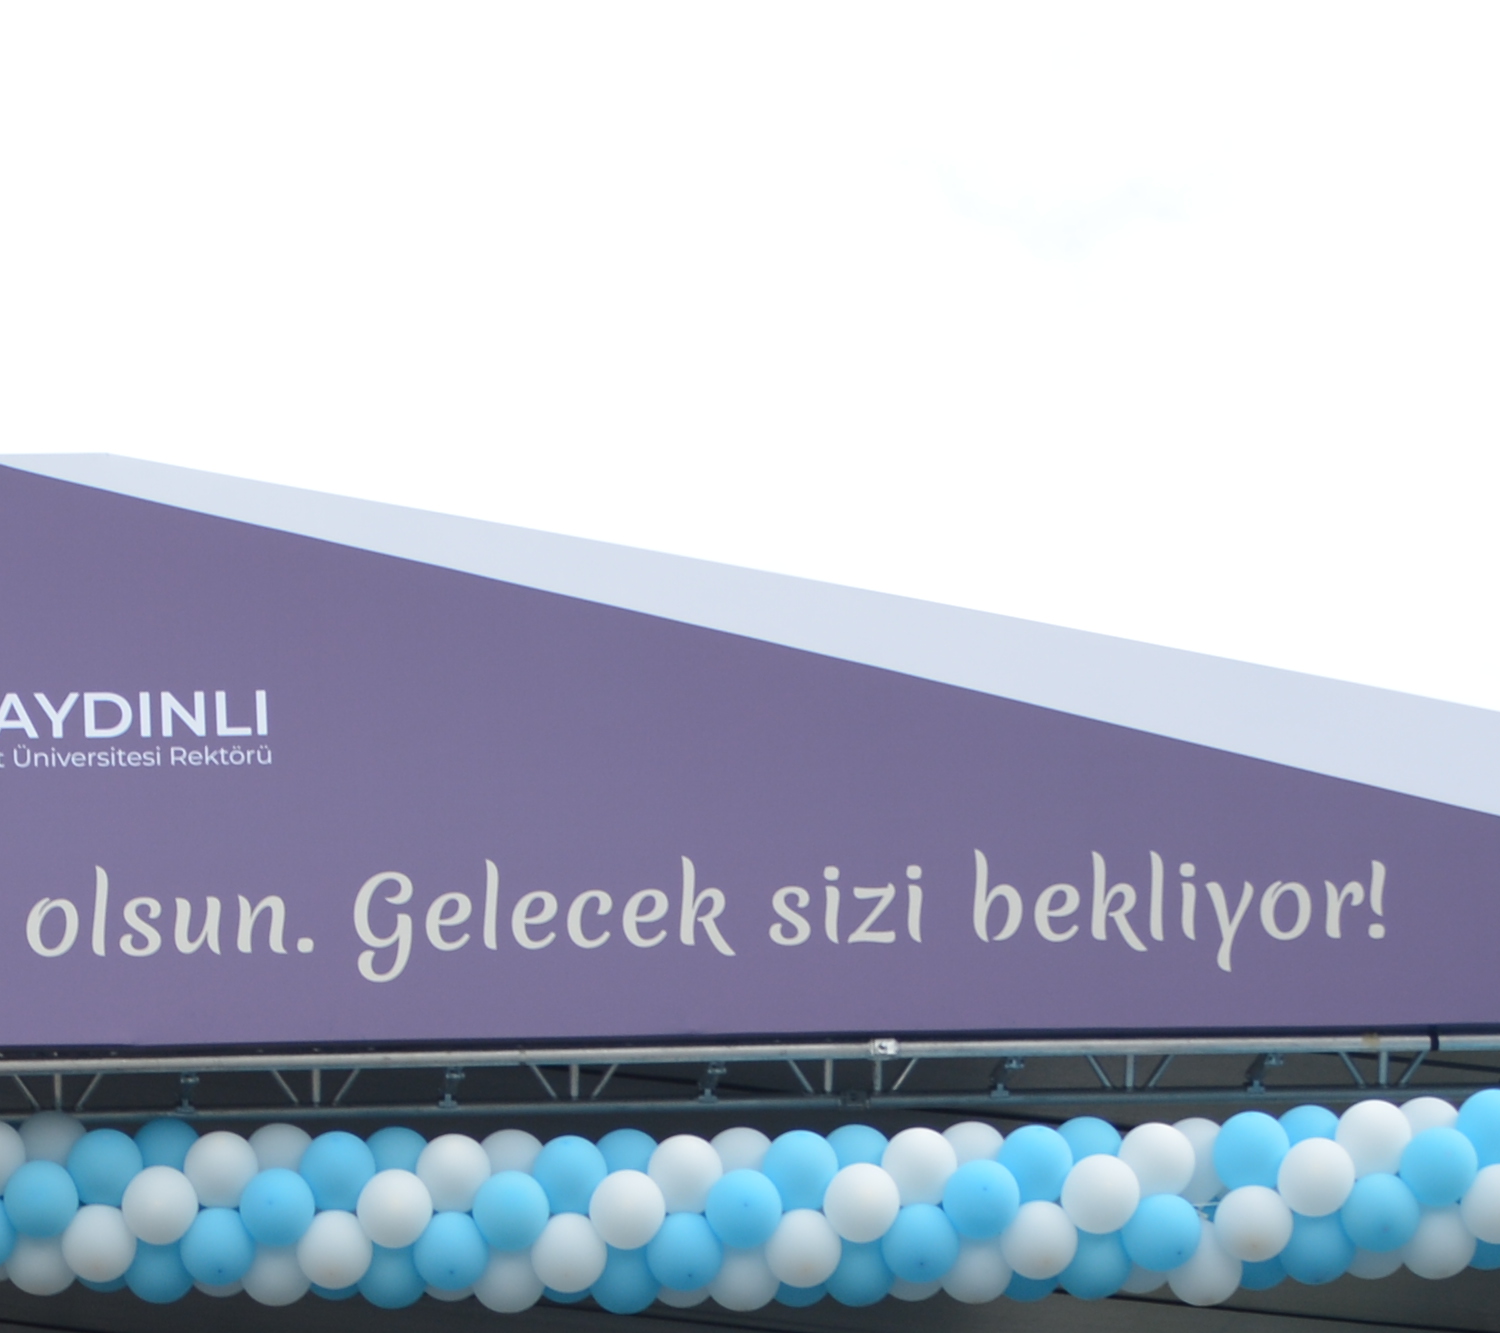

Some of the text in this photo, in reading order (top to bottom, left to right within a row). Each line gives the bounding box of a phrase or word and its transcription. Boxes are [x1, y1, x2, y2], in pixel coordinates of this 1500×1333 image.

[12, 744, 162, 768] Üniversitesi
[169, 744, 273, 766] Rektörü
[25, 864, 315, 958] olsun.
[353, 855, 736, 983] Gelecek
[768, 864, 923, 946] sizi
[973, 848, 1386, 972] bekliyor!
